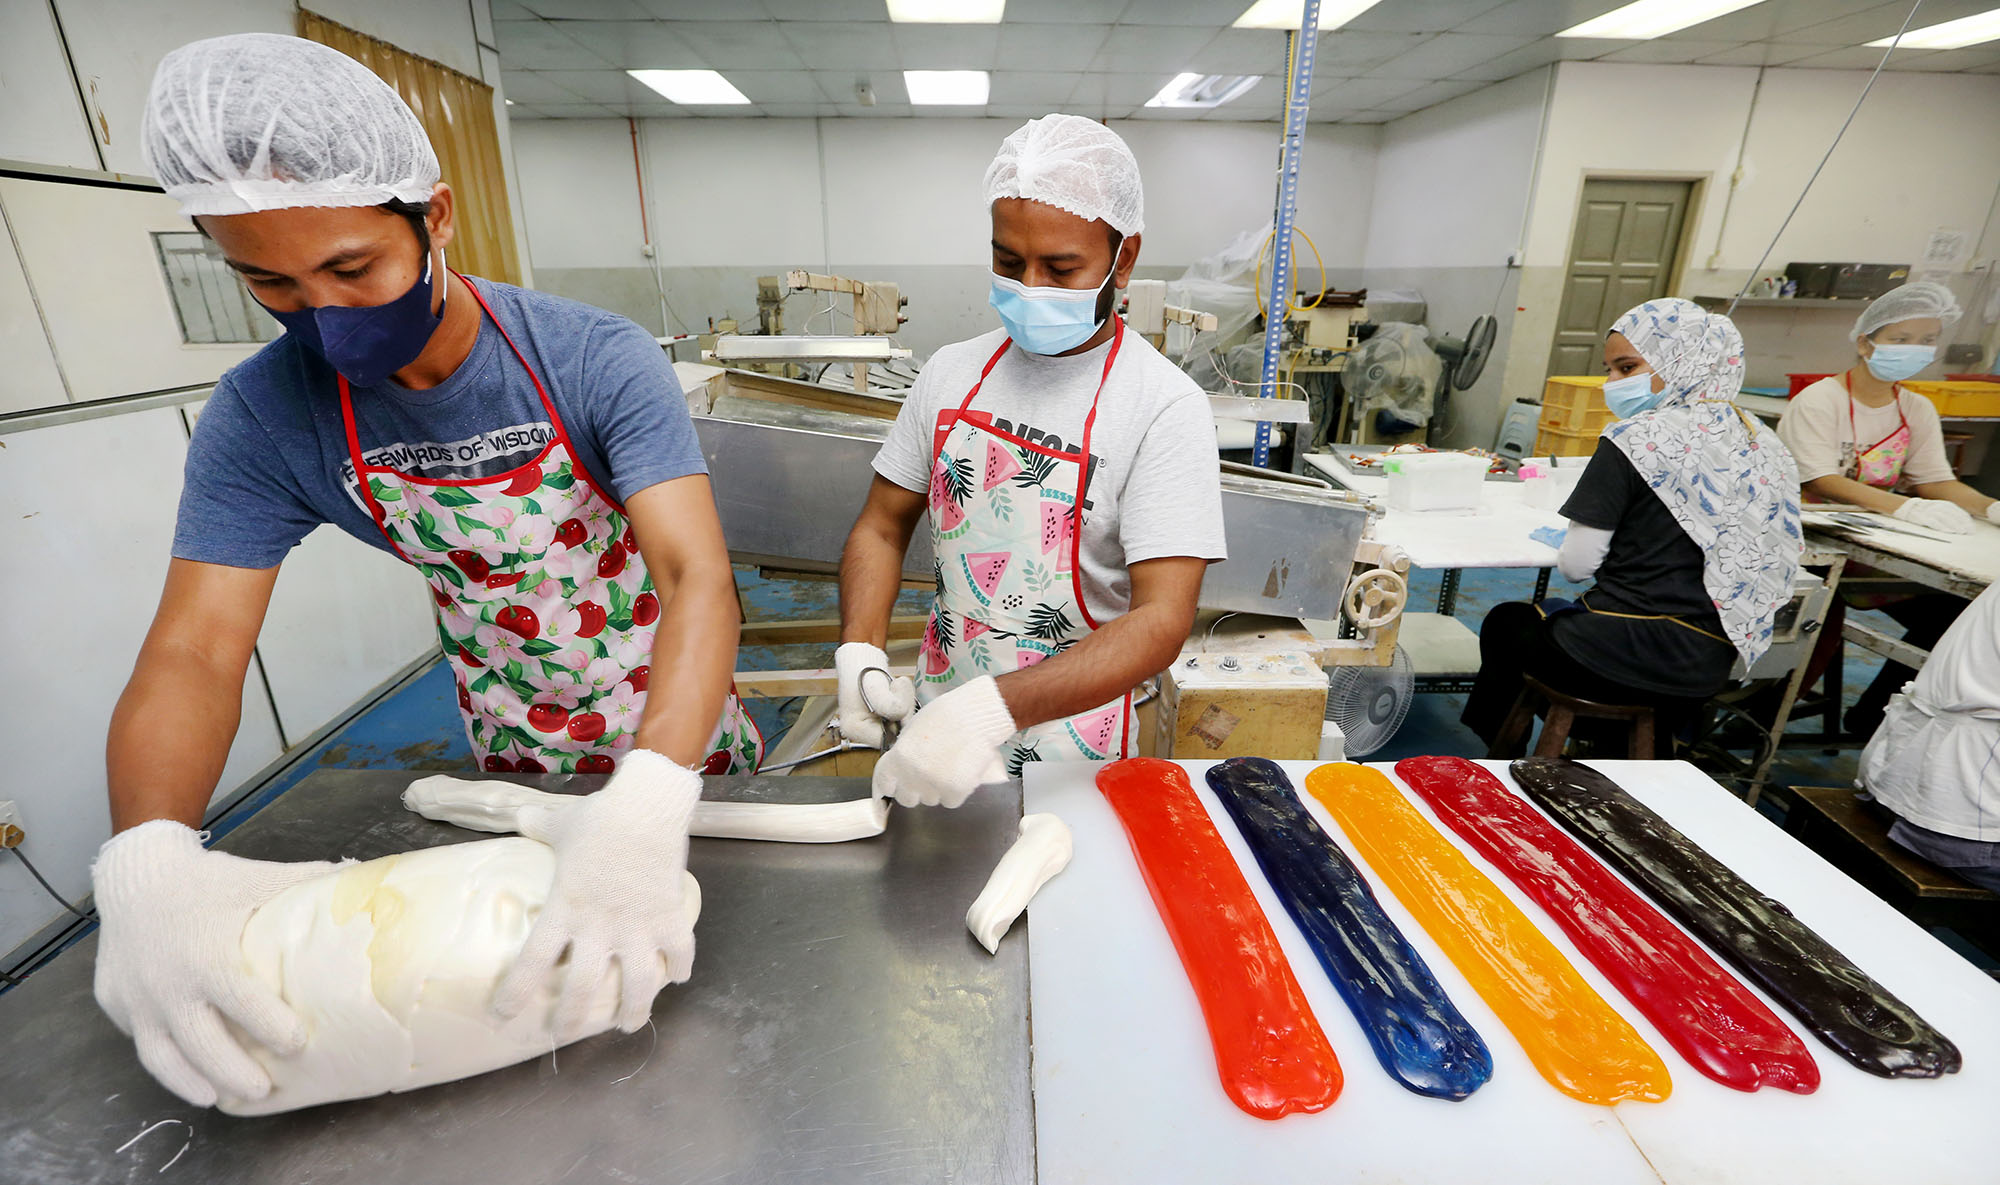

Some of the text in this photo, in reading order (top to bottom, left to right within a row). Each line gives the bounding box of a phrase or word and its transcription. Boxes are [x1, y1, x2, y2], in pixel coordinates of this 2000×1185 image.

[342, 428, 556, 482] FEEWRDS OF WISDOM
